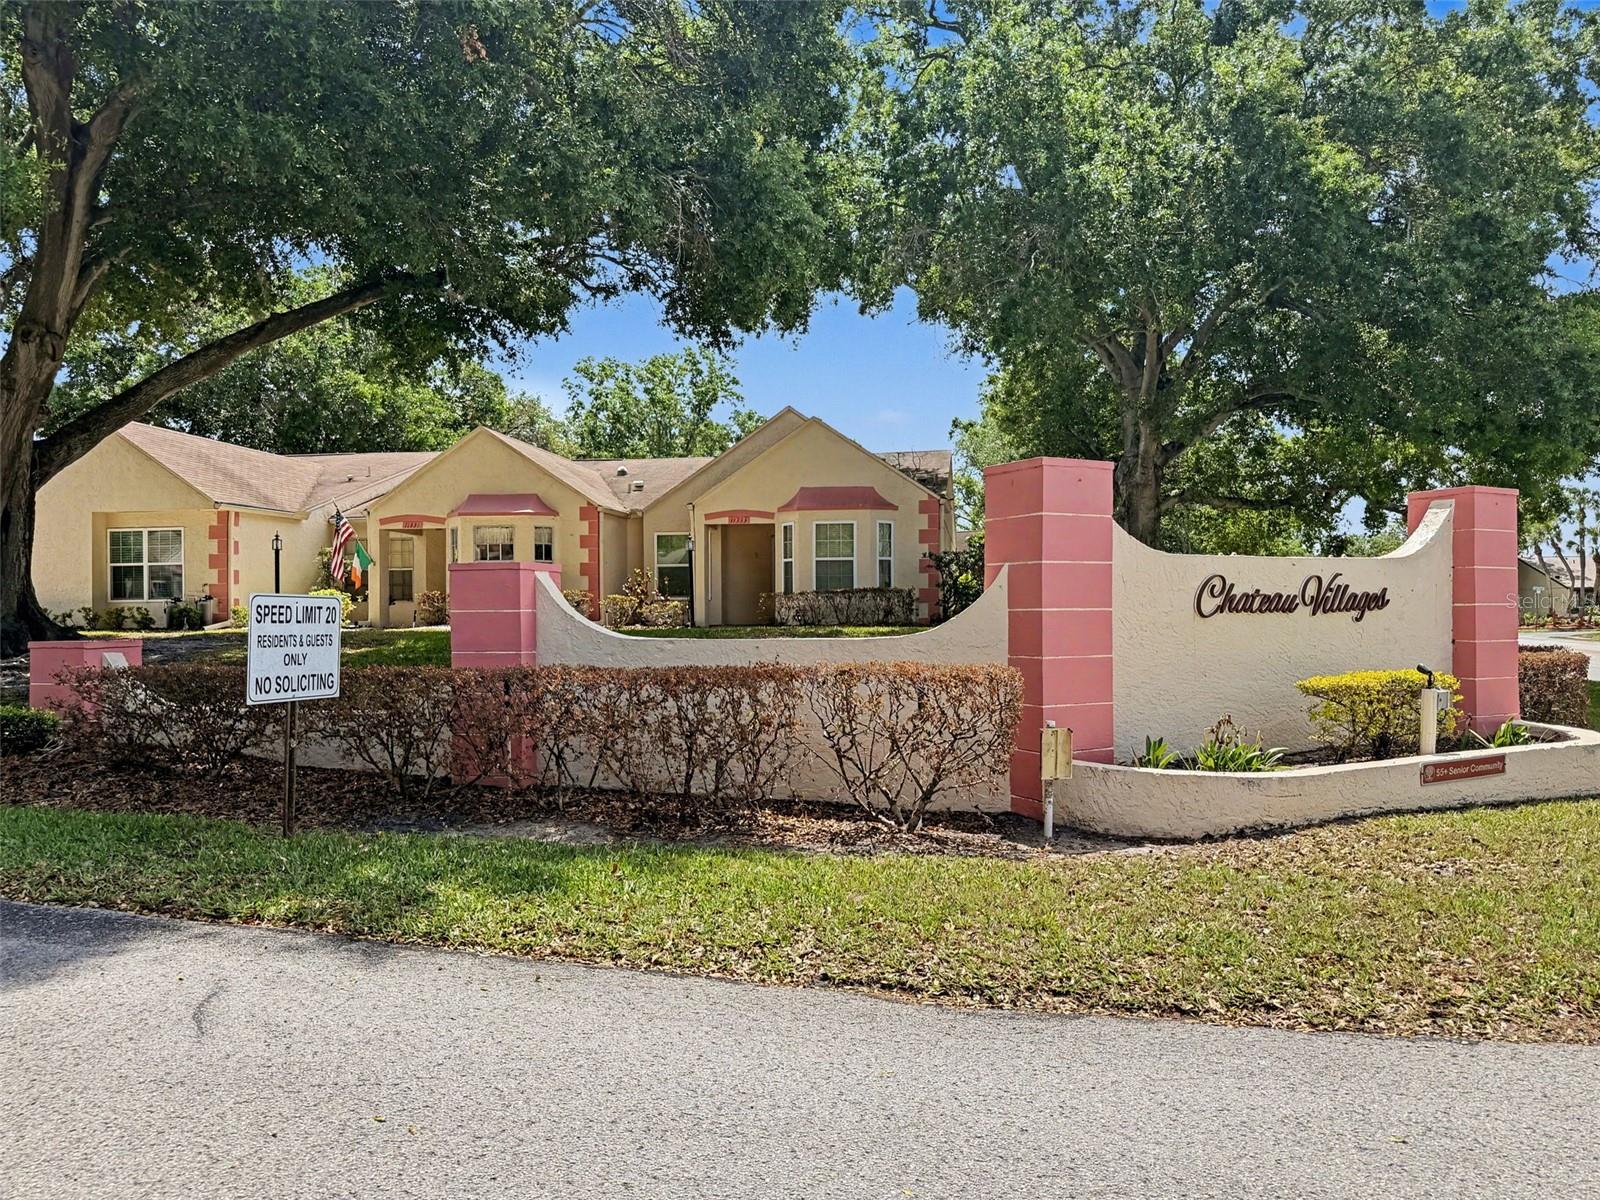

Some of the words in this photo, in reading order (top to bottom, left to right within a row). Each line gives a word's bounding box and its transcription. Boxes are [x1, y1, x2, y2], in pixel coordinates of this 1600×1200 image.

[1194, 574, 1299, 618] Chateau
[1300, 572, 1390, 622] Villages
[255, 604, 293, 624] SPEED
[295, 605, 323, 624] LIMIT
[325, 606, 337, 624] 20
[257, 634, 298, 648] RESIDENTS
[299, 634, 304, 647] &
[305, 634, 333, 647] GUESTS
[283, 653, 308, 666] ONLY
[255, 676, 272, 695] NO
[274, 672, 335, 694] SOLICITING
[1449, 766, 1470, 775] Senior
[1470, 761, 1503, 772] Community
